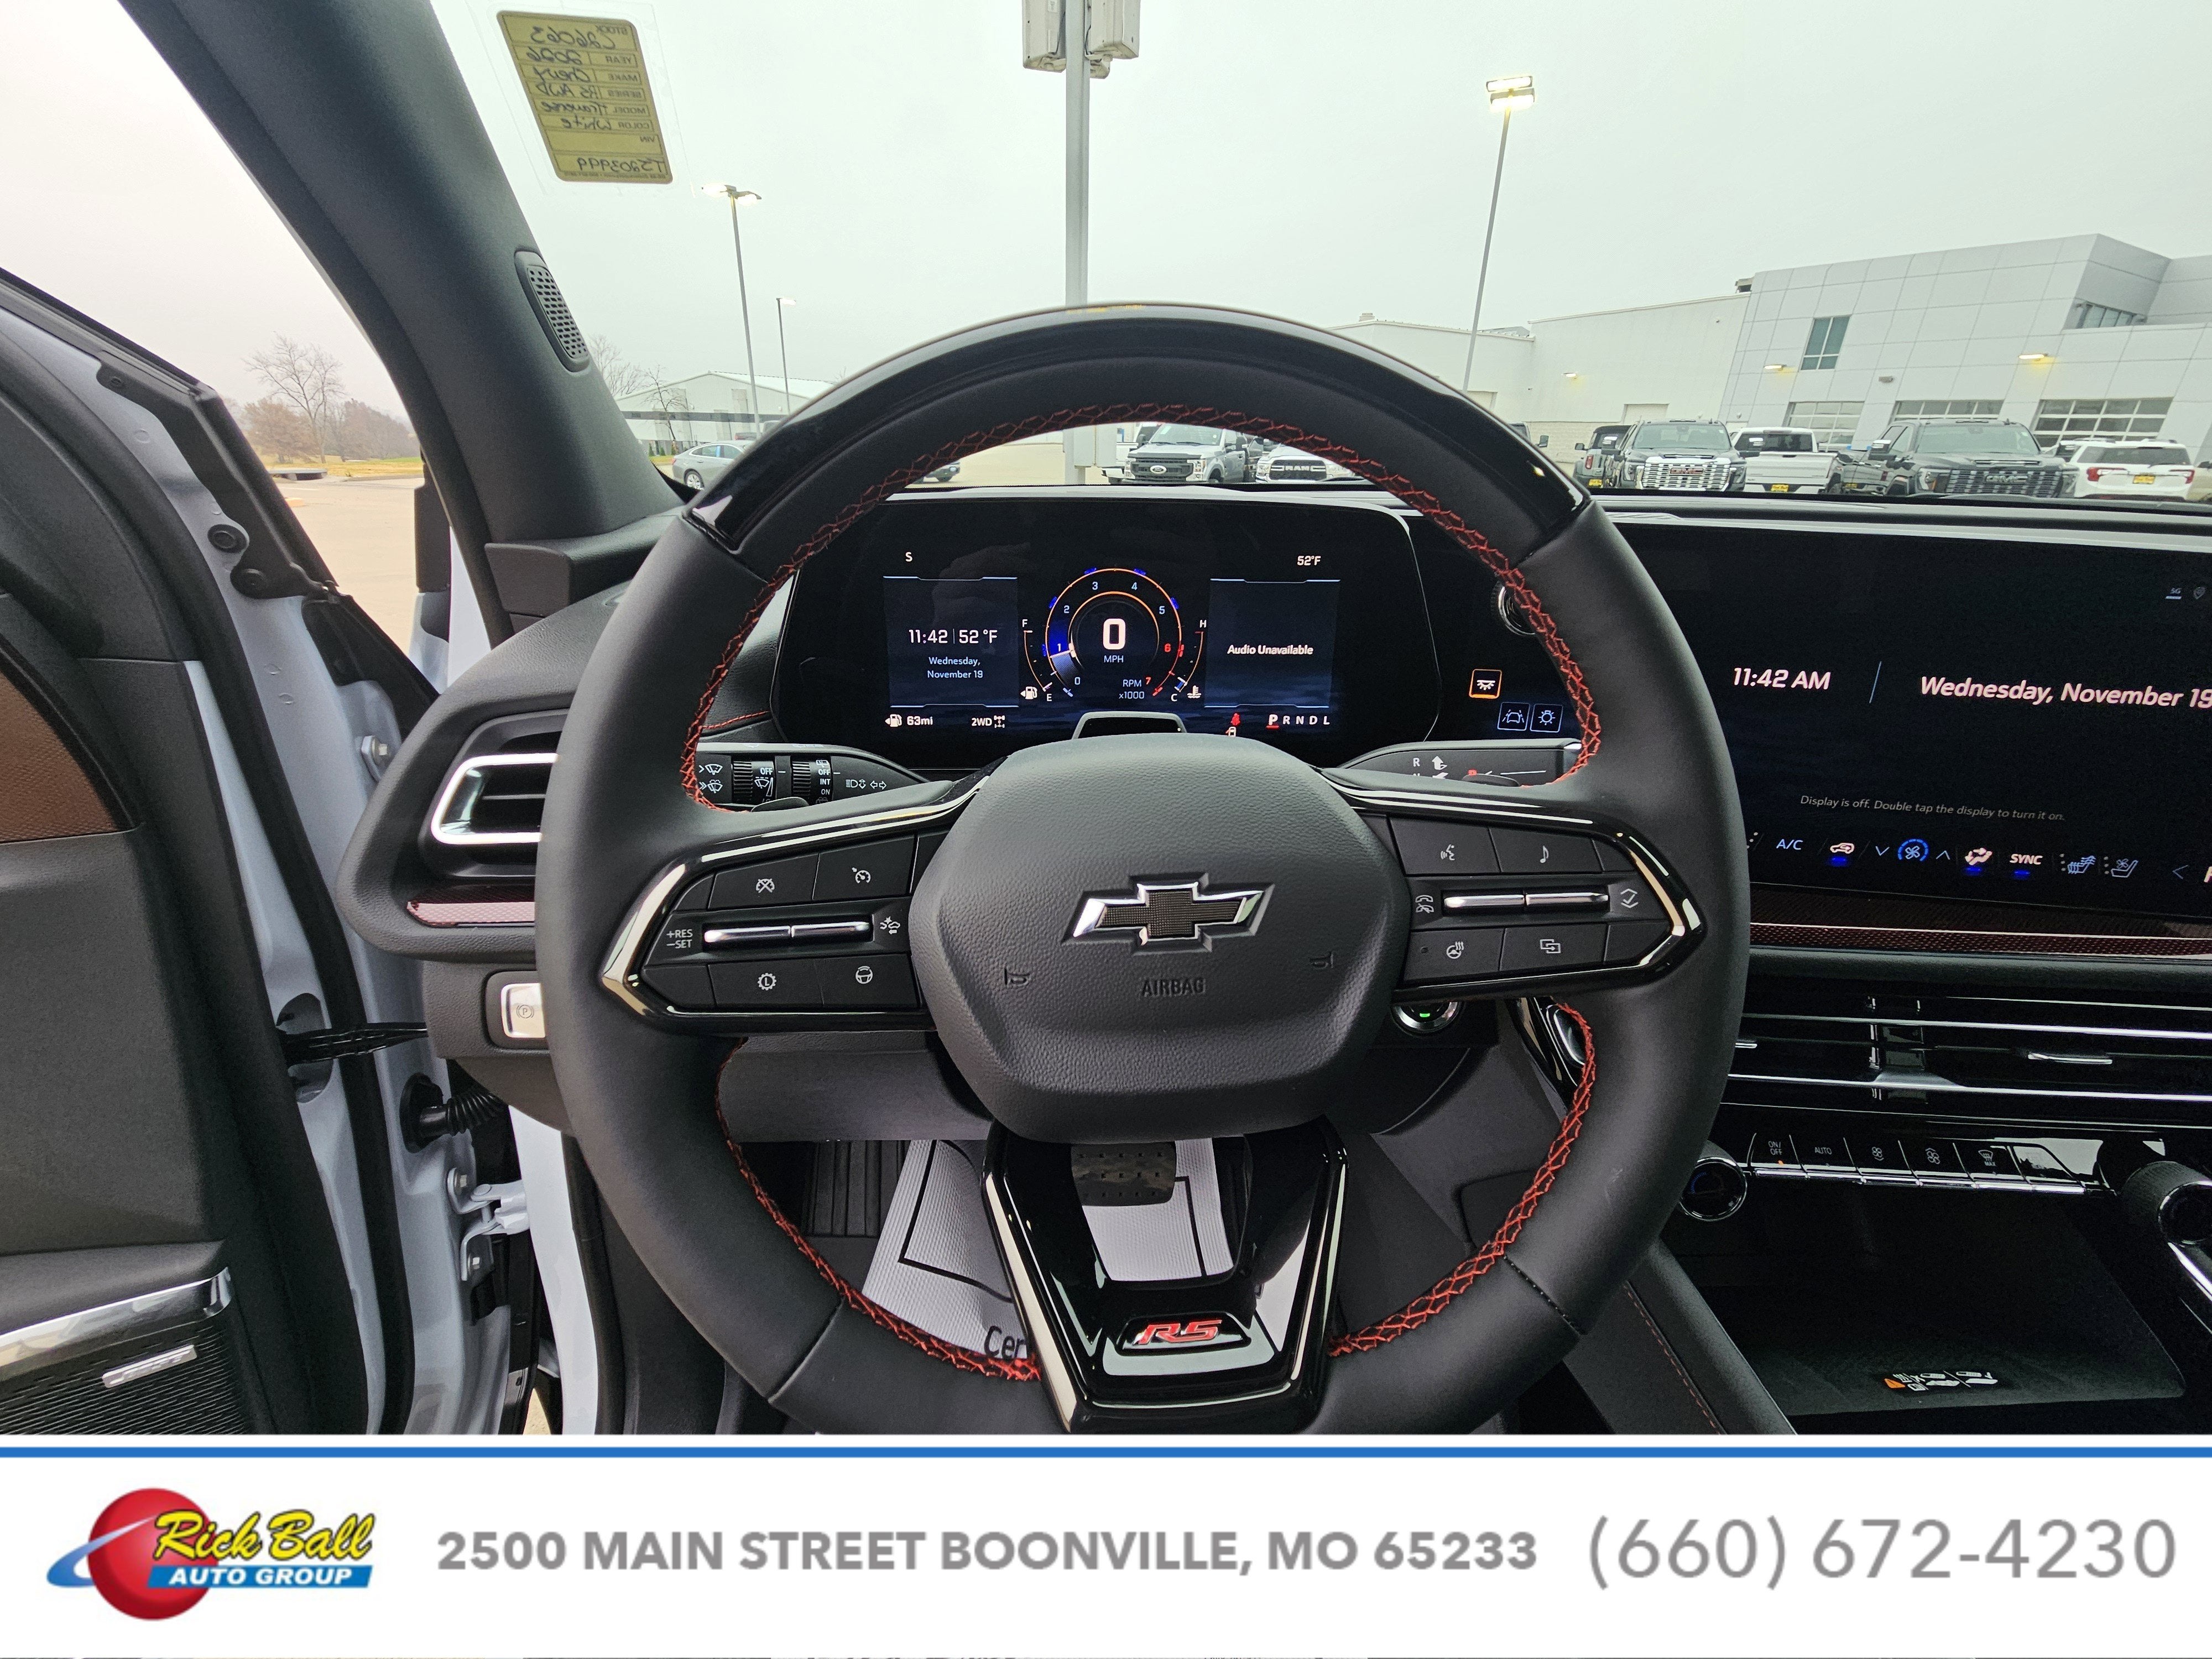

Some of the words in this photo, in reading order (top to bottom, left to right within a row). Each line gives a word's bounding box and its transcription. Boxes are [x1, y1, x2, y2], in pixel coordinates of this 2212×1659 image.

[905, 551, 913, 562] S
[1297, 555, 1321, 566] 52°F
[1092, 581, 1098, 591] 3
[1131, 582, 1138, 591] 4
[1063, 605, 1070, 614] 2
[1159, 606, 1165, 615] 5
[1022, 619, 1028, 628] F
[1199, 619, 1207, 628] H
[909, 629, 948, 644] 11:42
[959, 629, 979, 644] 52
[983, 629, 998, 644] °F
[1103, 618, 1126, 650] 0
[1057, 643, 1061, 651] 1
[1164, 643, 1171, 653] 6
[1227, 644, 1256, 655] Audio
[1258, 644, 1314, 655] Unavailable
[928, 656, 980, 666] Wednesday,
[1104, 655, 1124, 663] MPH
[927, 670, 971, 679] November
[973, 670, 983, 679] 19
[1734, 667, 1790, 688] 11:42
[1791, 670, 1831, 690] AM
[1074, 677, 1081, 685] 0
[1123, 679, 1142, 687] RPM
[1145, 676, 1151, 685] 7
[1046, 693, 1052, 702] E
[1118, 691, 1145, 700] x1000
[1171, 693, 1178, 702] C
[1921, 676, 2053, 706] Wednesday,
[2060, 682, 2184, 707] November
[2189, 688, 2212, 709] 19
[906, 716, 933, 726] 63mi
[971, 717, 993, 727] 2WD
[1269, 714, 1278, 725] P
[1282, 715, 1290, 725] R
[1296, 716, 1305, 725] N
[1309, 715, 1318, 725] D
[1323, 716, 1330, 725] L
[1413, 757, 1420, 767] R
[760, 767, 774, 775] OFF
[1801, 795, 1839, 808] Display
[1841, 798, 1850, 807] is
[1852, 799, 1870, 808] off.
[1874, 800, 1912, 811] Double
[1915, 803, 1933, 814] tap
[1936, 804, 1954, 813] the
[1957, 806, 1995, 818] display
[1998, 809, 2010, 817] to
[2012, 810, 2035, 819] turn
[2038, 811, 2046, 820] it
[1776, 838, 1803, 850] A/C
[2009, 853, 2043, 865] SYNC
[1141, 978, 1206, 997] AIRBAG
[1814, 1146, 1832, 1155] AUTO
[1136, 1319, 1223, 1345] RS
